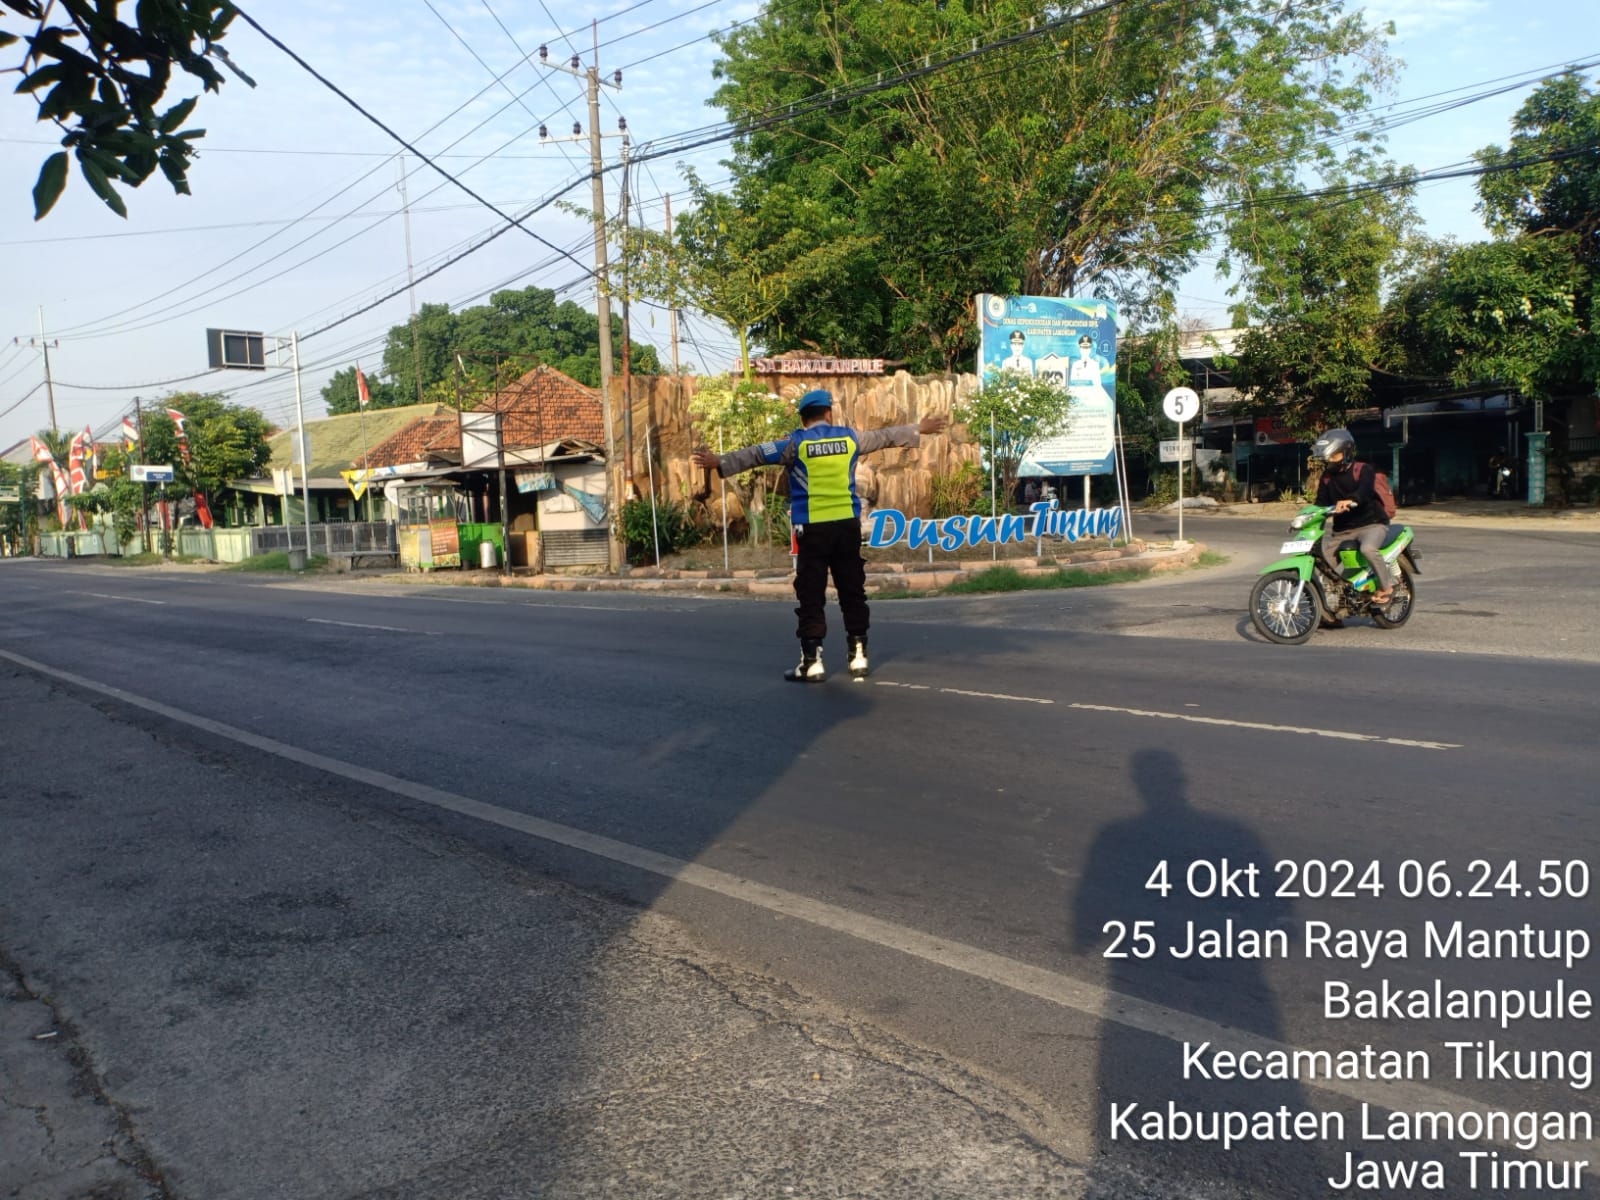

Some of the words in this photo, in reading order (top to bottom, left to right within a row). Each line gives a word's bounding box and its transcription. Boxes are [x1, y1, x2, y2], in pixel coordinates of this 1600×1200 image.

[781, 358, 884, 373] BAKALANPULE
[868, 508, 1024, 551] Dusun
[1030, 499, 1123, 543] Tikung
